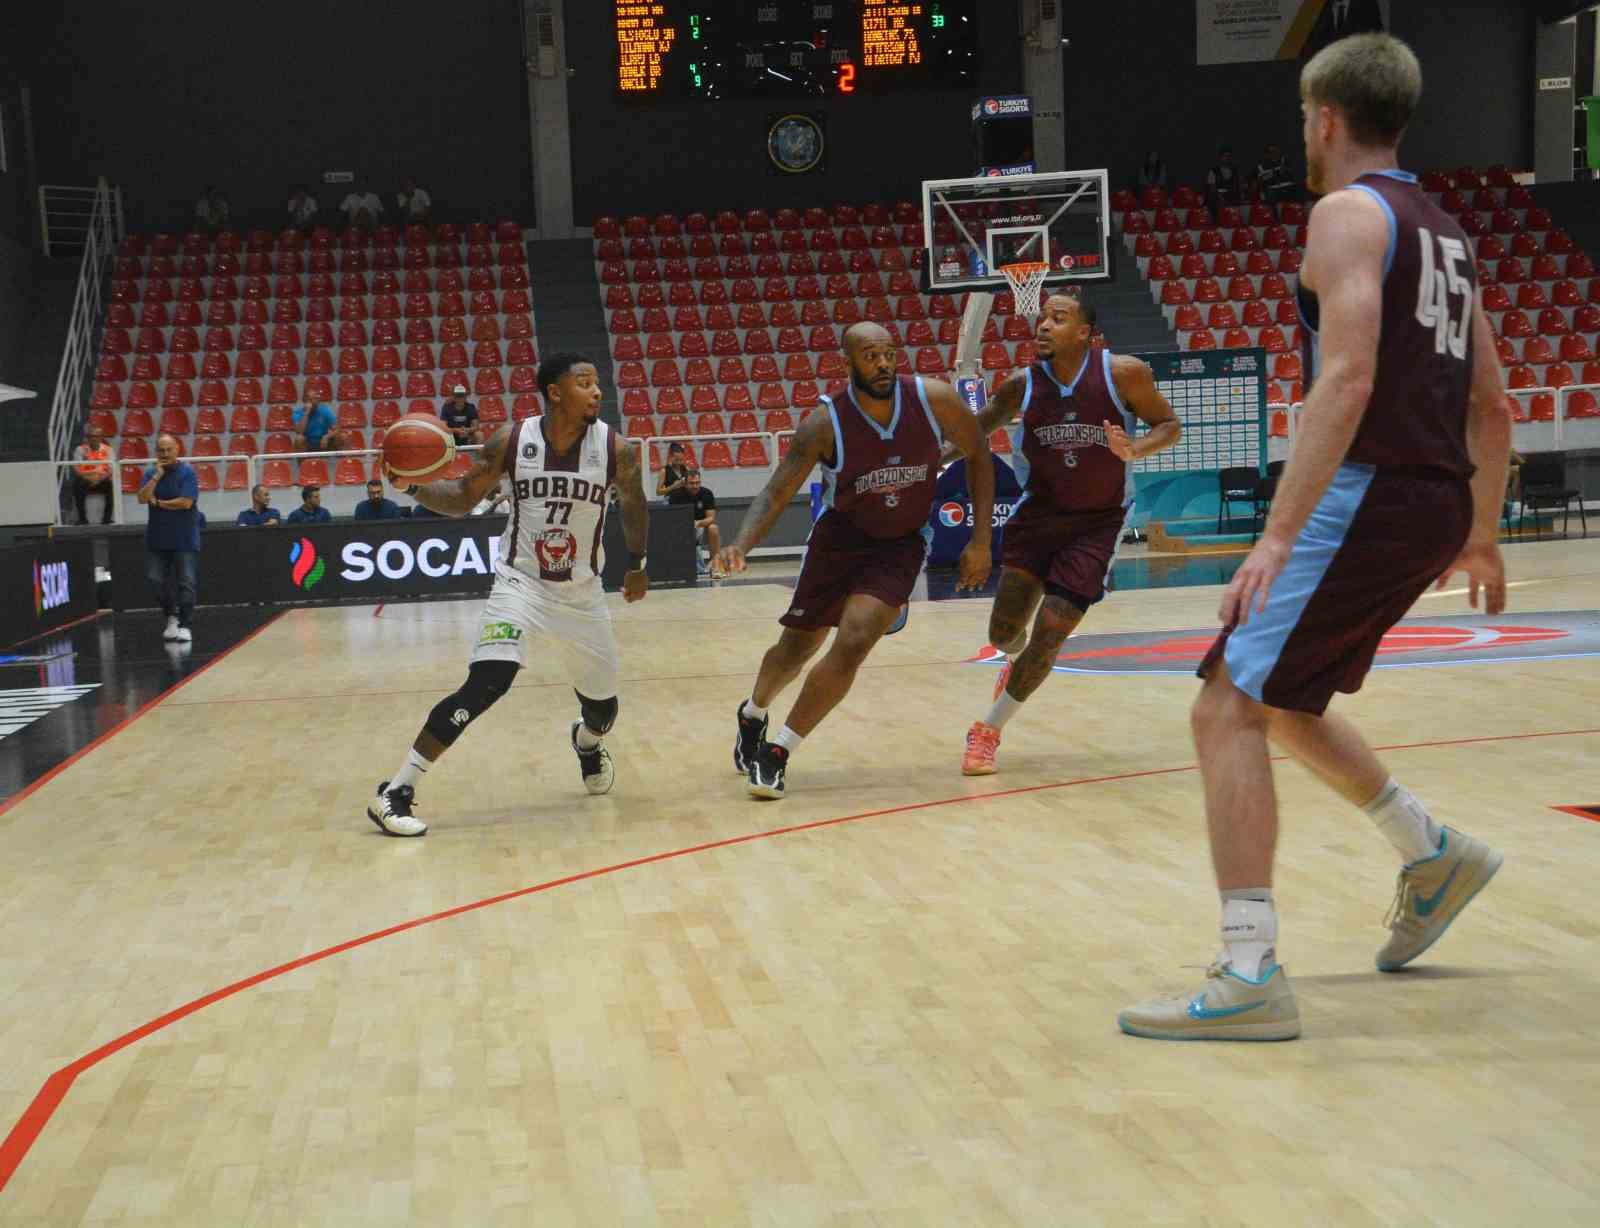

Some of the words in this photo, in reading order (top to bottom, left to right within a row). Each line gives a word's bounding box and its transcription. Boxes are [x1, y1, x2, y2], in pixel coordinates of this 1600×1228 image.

[692, 27, 700, 39] 2
[689, 63, 696, 74] 4
[839, 63, 856, 92] 2
[694, 75, 702, 87] 9
[1415, 226, 1472, 360] 45
[1032, 422, 1107, 448] TRABZONSPO
[515, 476, 605, 504] BORDO
[544, 501, 573, 524] 77
[966, 503, 1017, 515] TKIY
[41, 560, 70, 610] SOCAR
